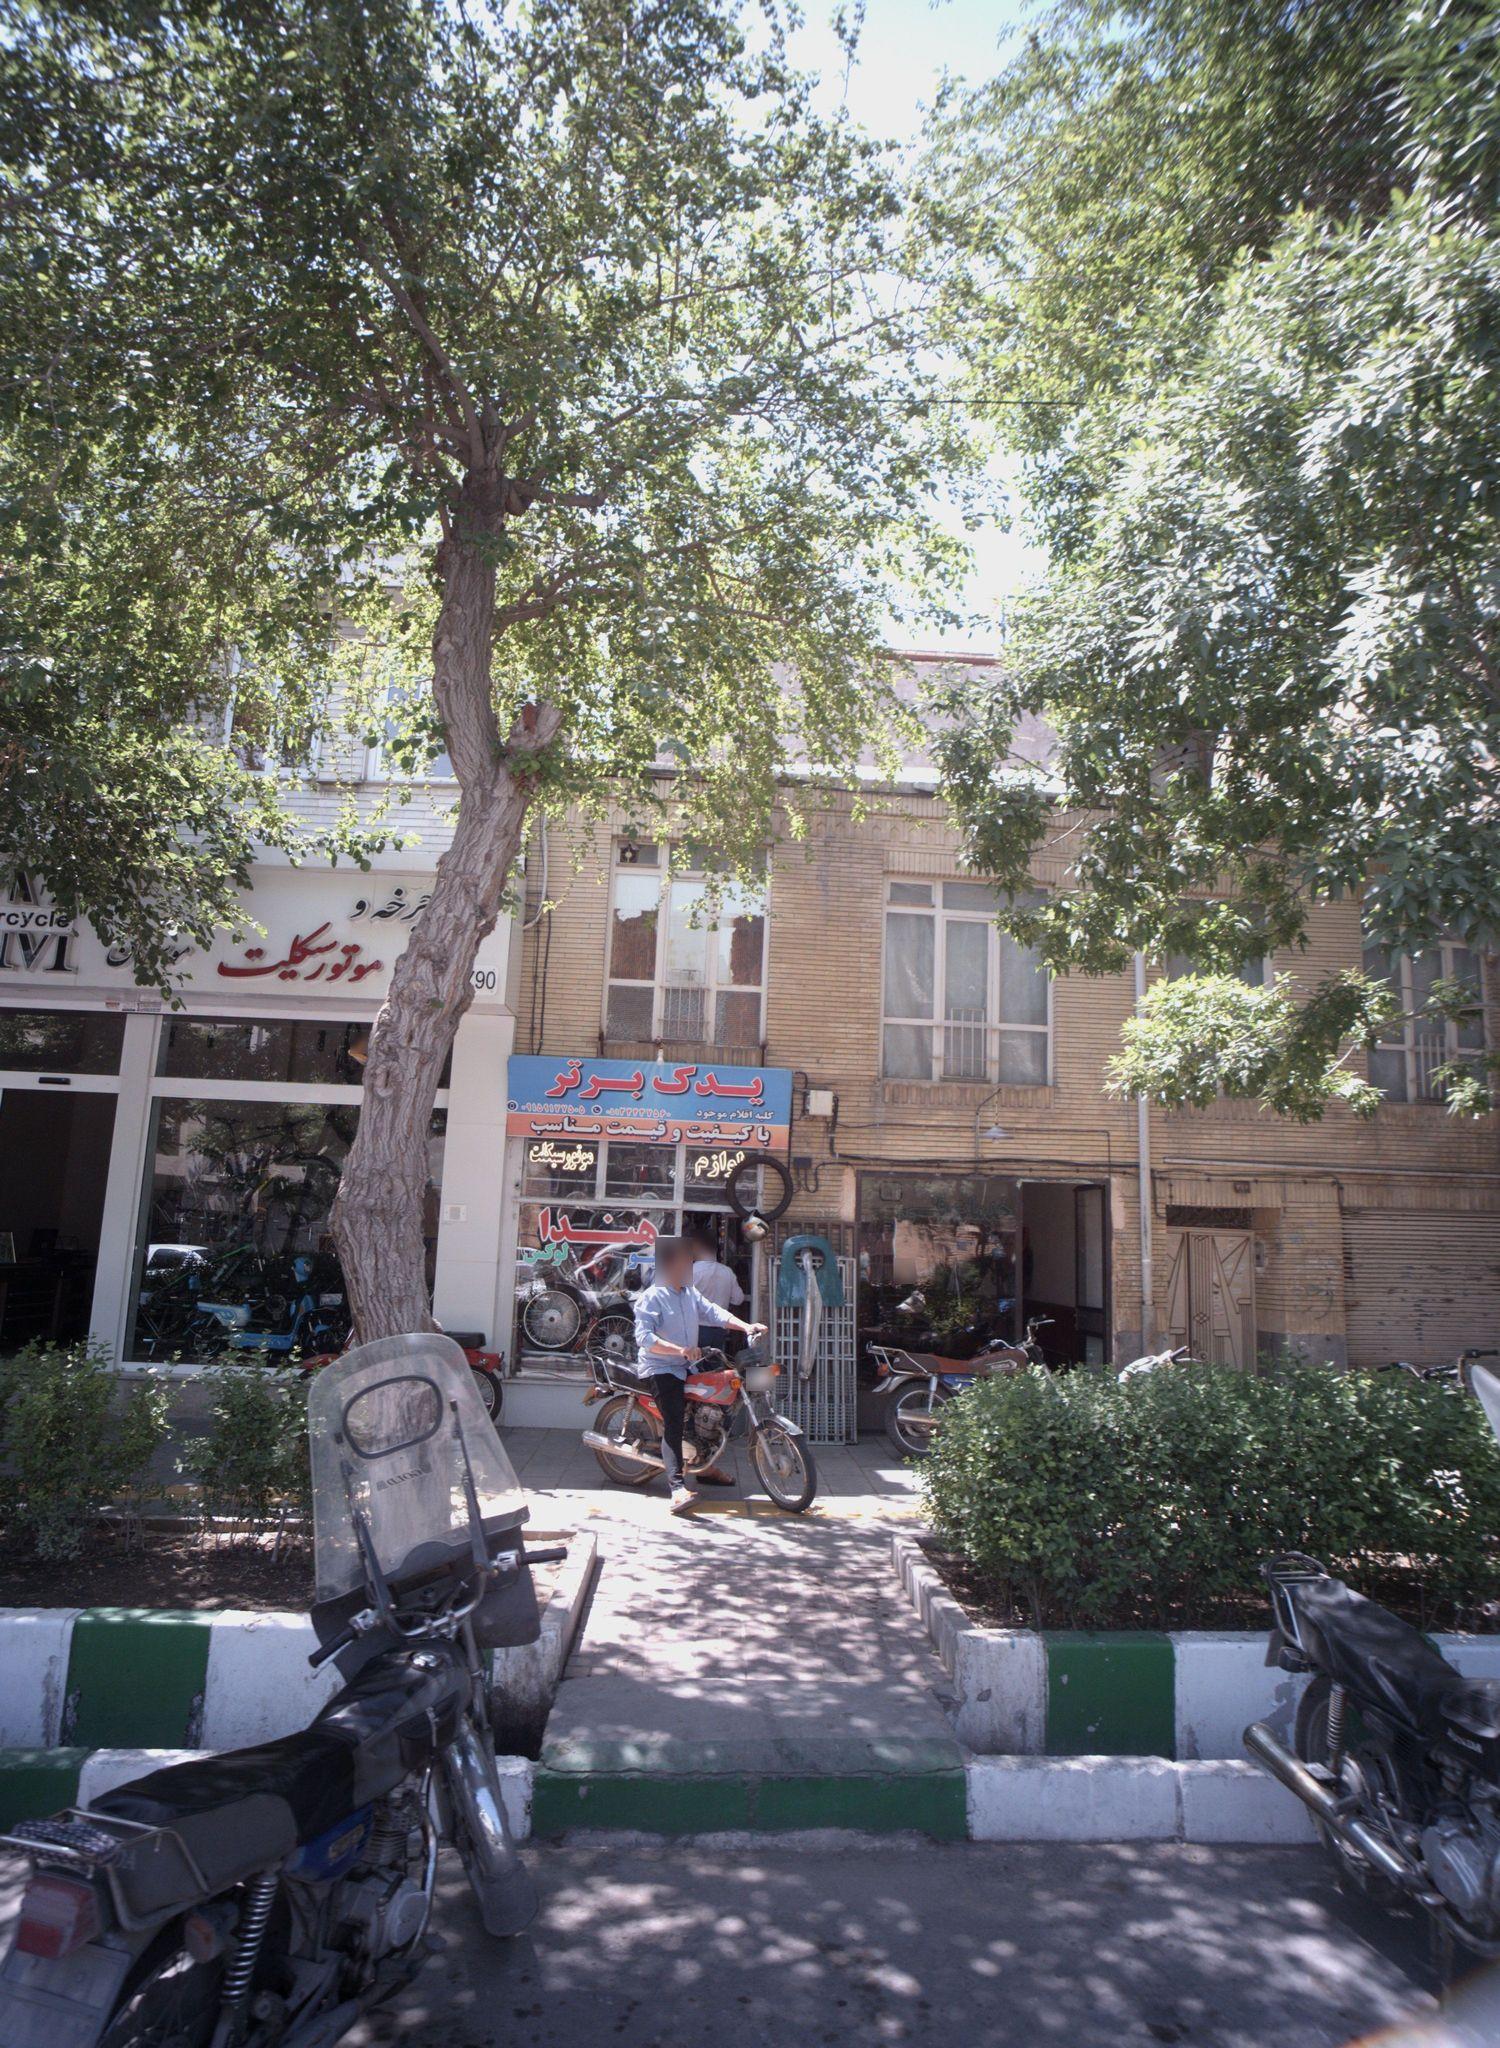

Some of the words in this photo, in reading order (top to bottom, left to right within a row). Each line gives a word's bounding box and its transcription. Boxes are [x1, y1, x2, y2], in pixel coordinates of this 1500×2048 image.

[470, 970, 497, 990] 90
[545, 1059, 645, 1101] برتر
[652, 1065, 765, 1107] یدک
[530, 1115, 601, 1136] مناسب
[606, 1119, 667, 1140] قیمت
[670, 1127, 682, 1143] و
[686, 1123, 755, 1145] کیفیت
[756, 1124, 771, 1147] با
[538, 1206, 660, 1246] هندا
